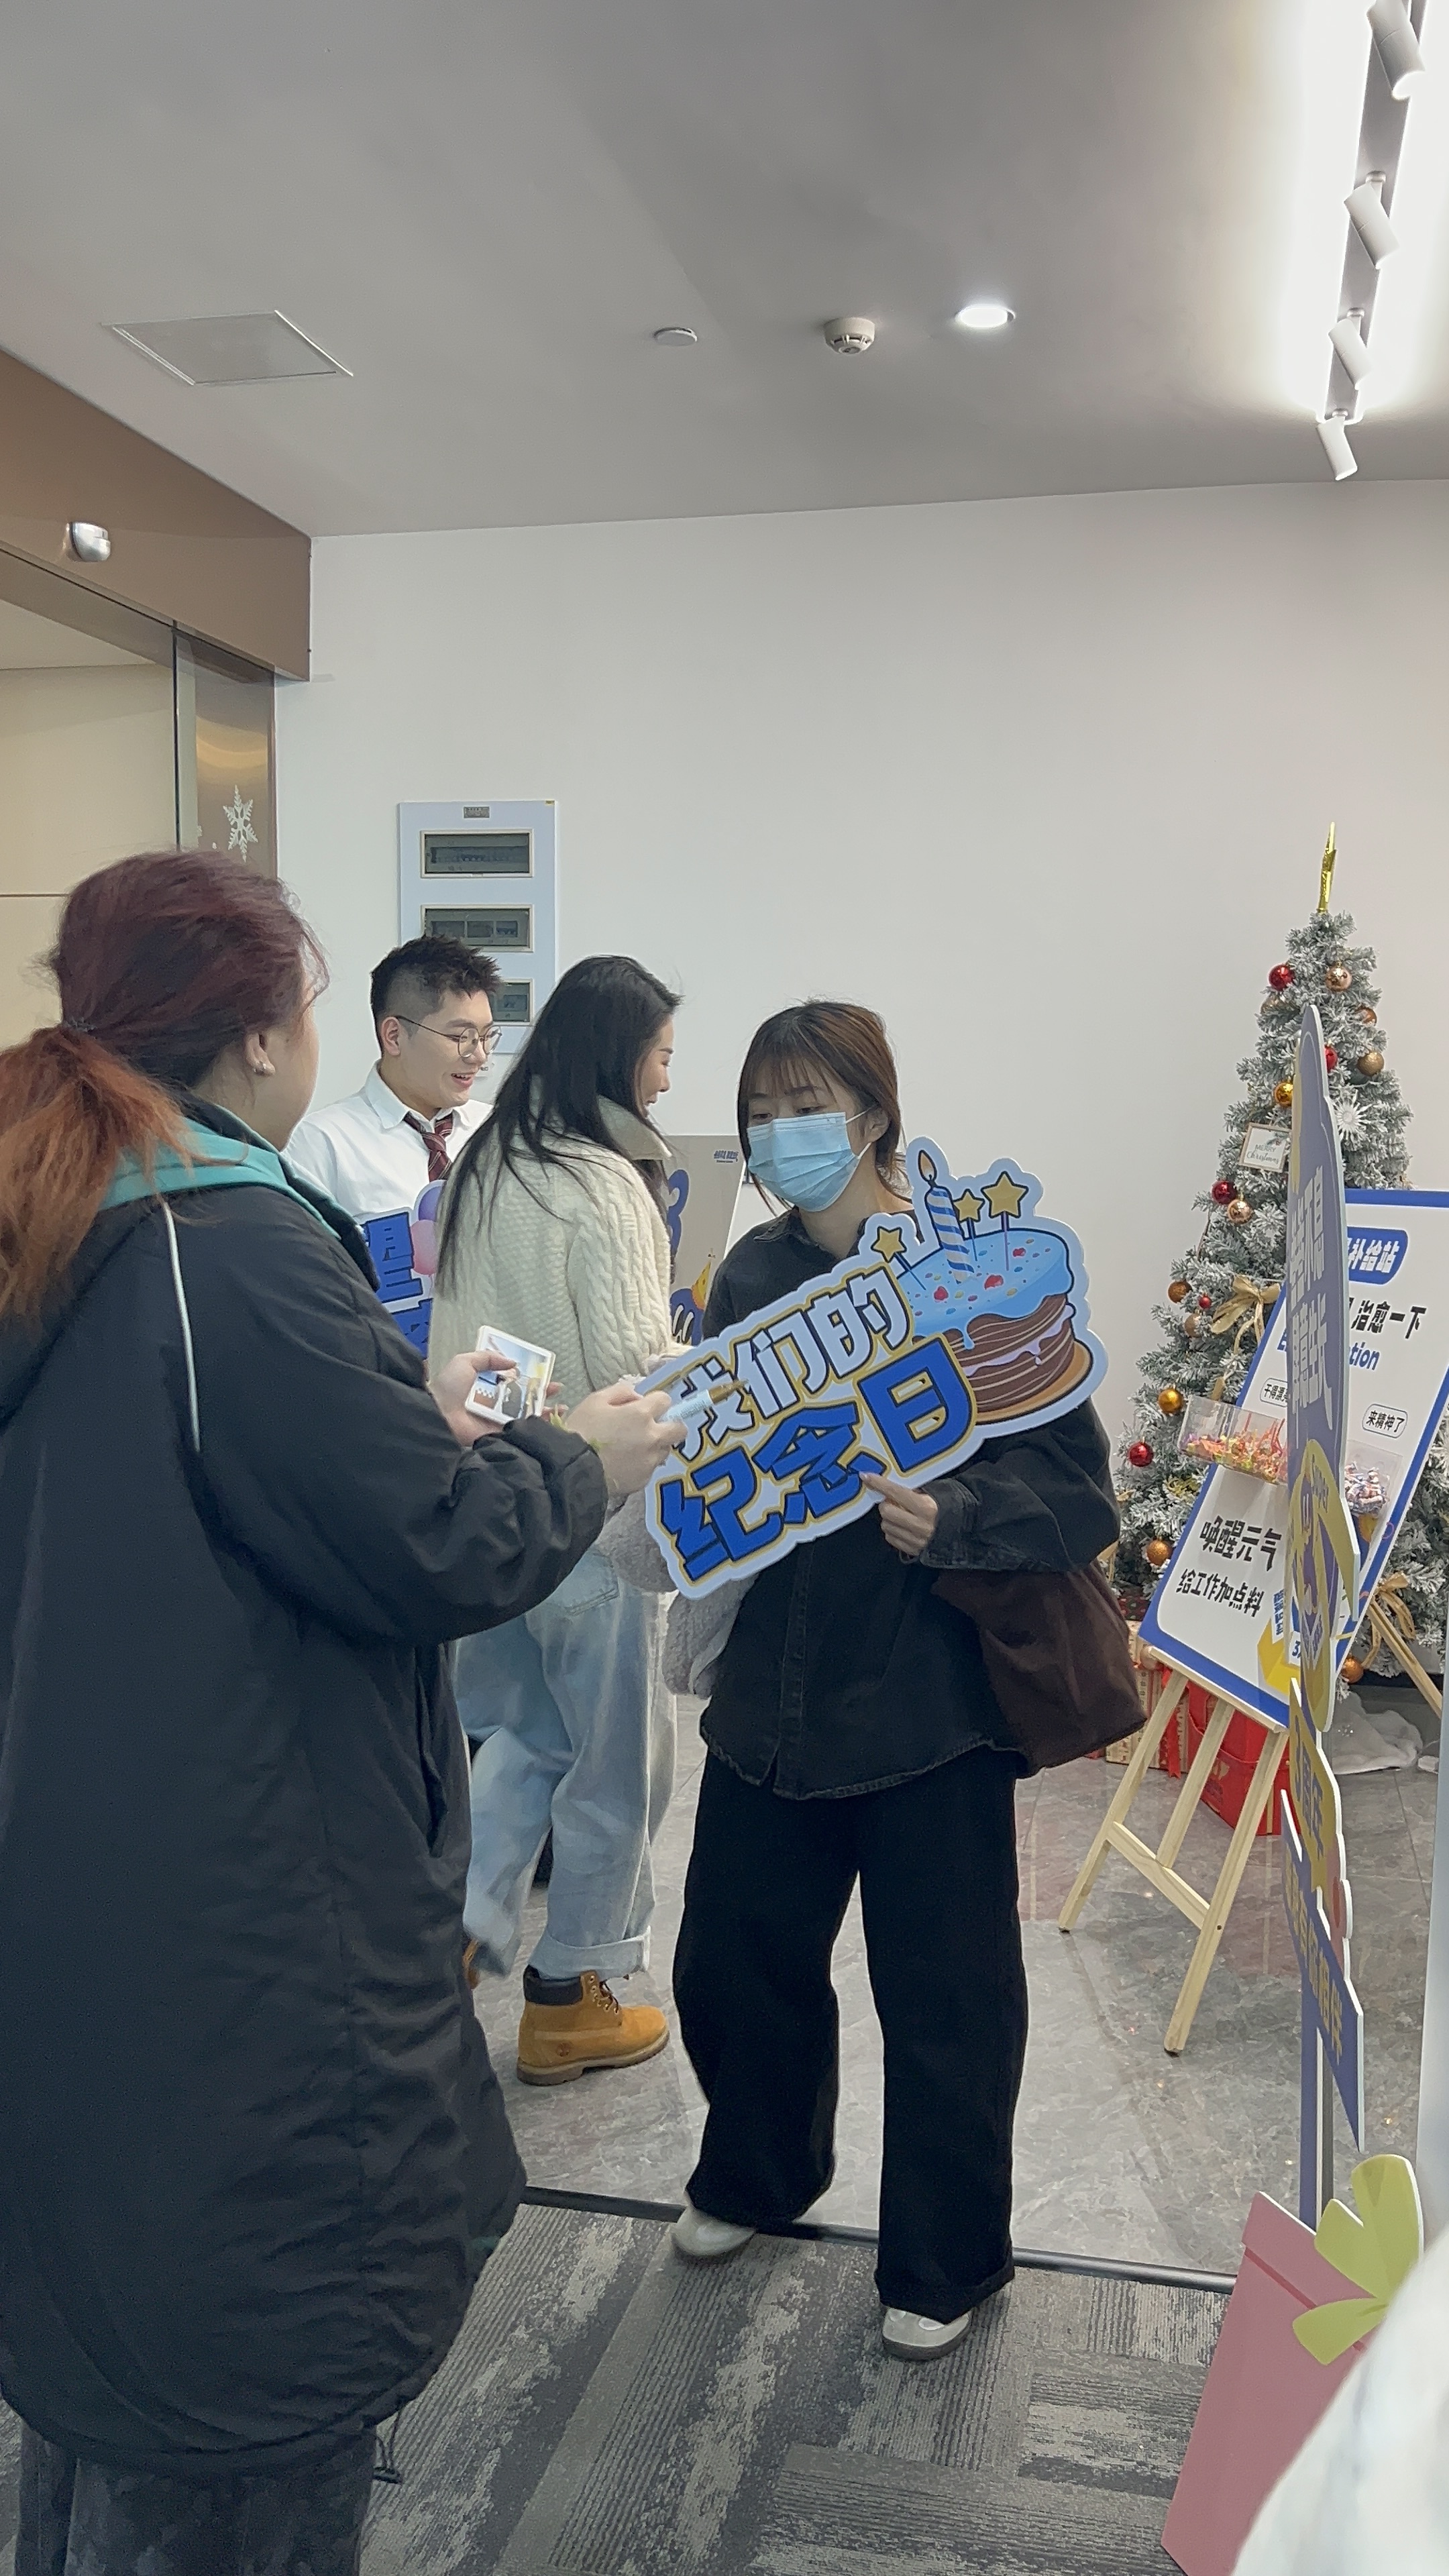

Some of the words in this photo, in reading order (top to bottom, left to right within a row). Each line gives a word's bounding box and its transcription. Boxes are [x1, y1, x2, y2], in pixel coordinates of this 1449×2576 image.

[1348, 1238, 1399, 1273] 补给站
[1348, 1297, 1427, 1339] 治愈一下
[672, 1266, 911, 1460] 我们的
[1348, 1342, 1381, 1371] tion
[1366, 1410, 1405, 1433] 来精神了
[661, 1338, 973, 1581] 纪念日
[1199, 1515, 1282, 1572] 唤醒元气
[1175, 1568, 1265, 1617] 给工作加点料
